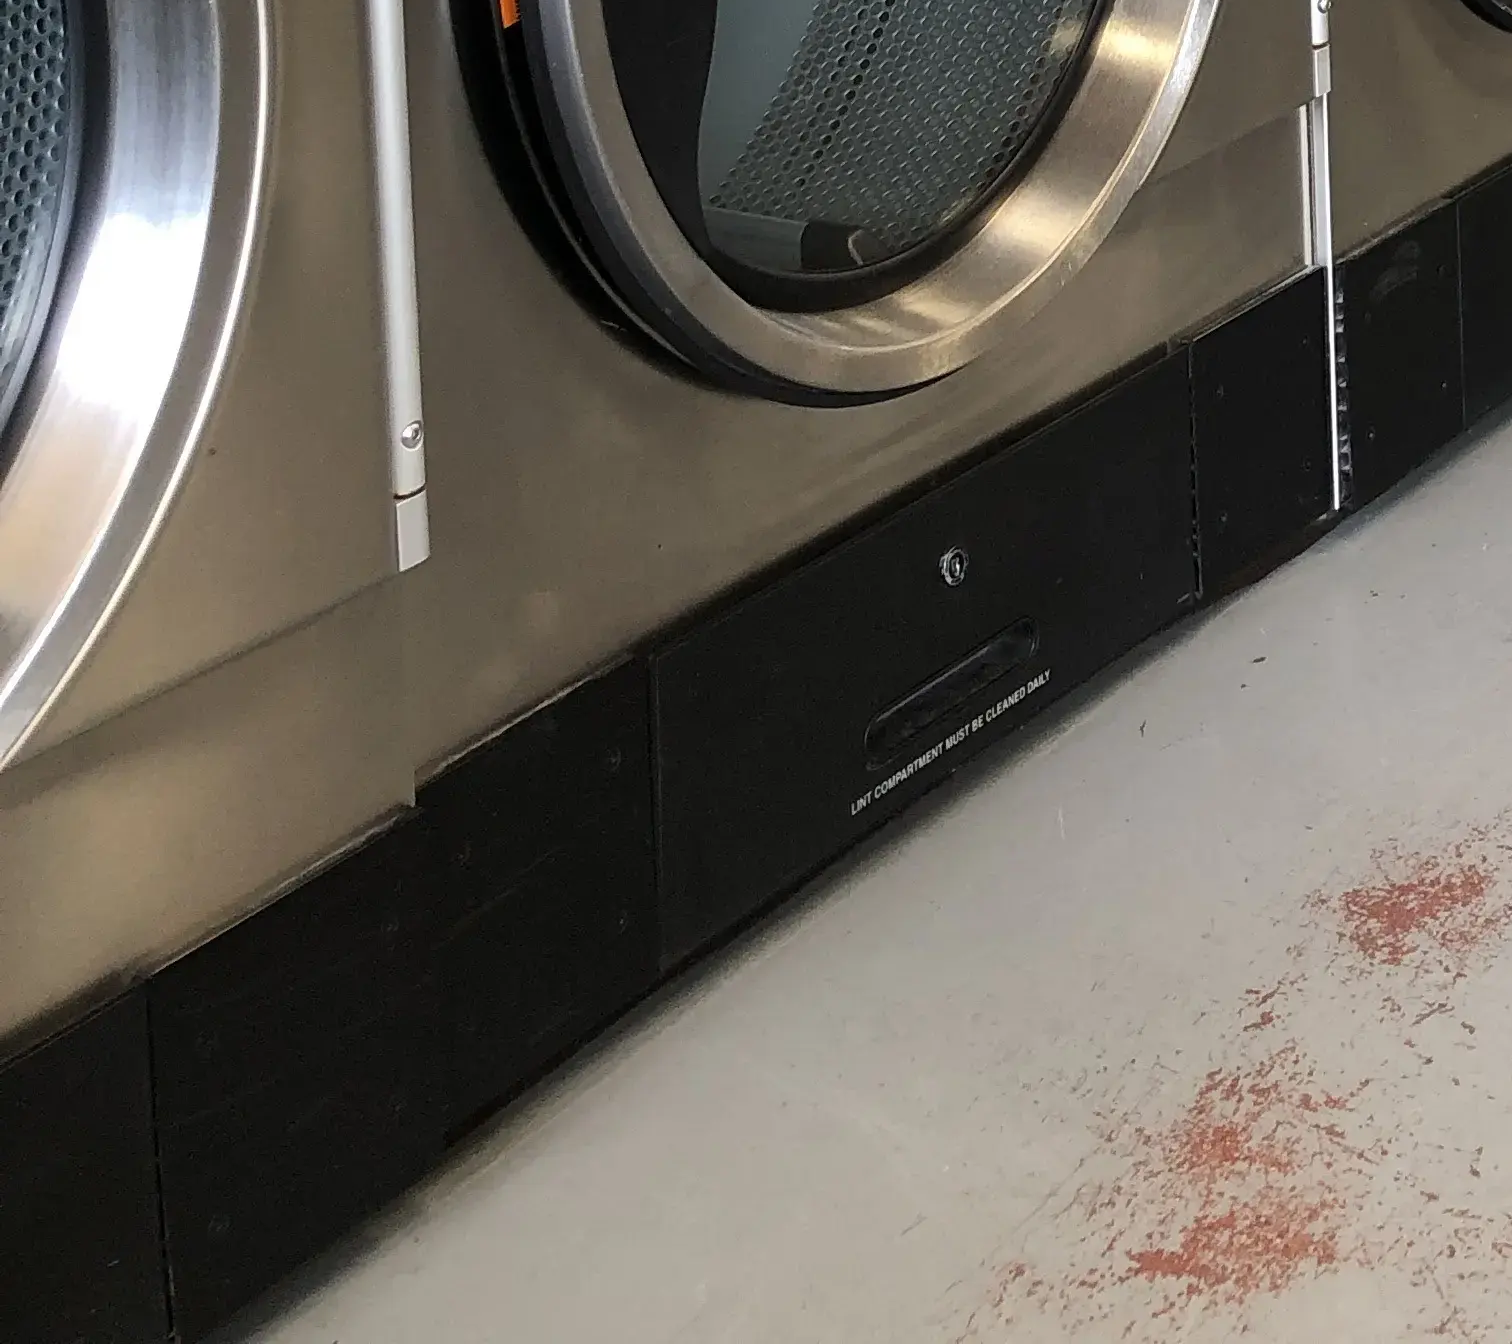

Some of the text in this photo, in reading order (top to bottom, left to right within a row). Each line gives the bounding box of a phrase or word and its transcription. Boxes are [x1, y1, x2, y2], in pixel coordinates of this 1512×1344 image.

[851, 667, 1052, 816] LINT COMPARTMENT MUST BE CLEANED DAILY
